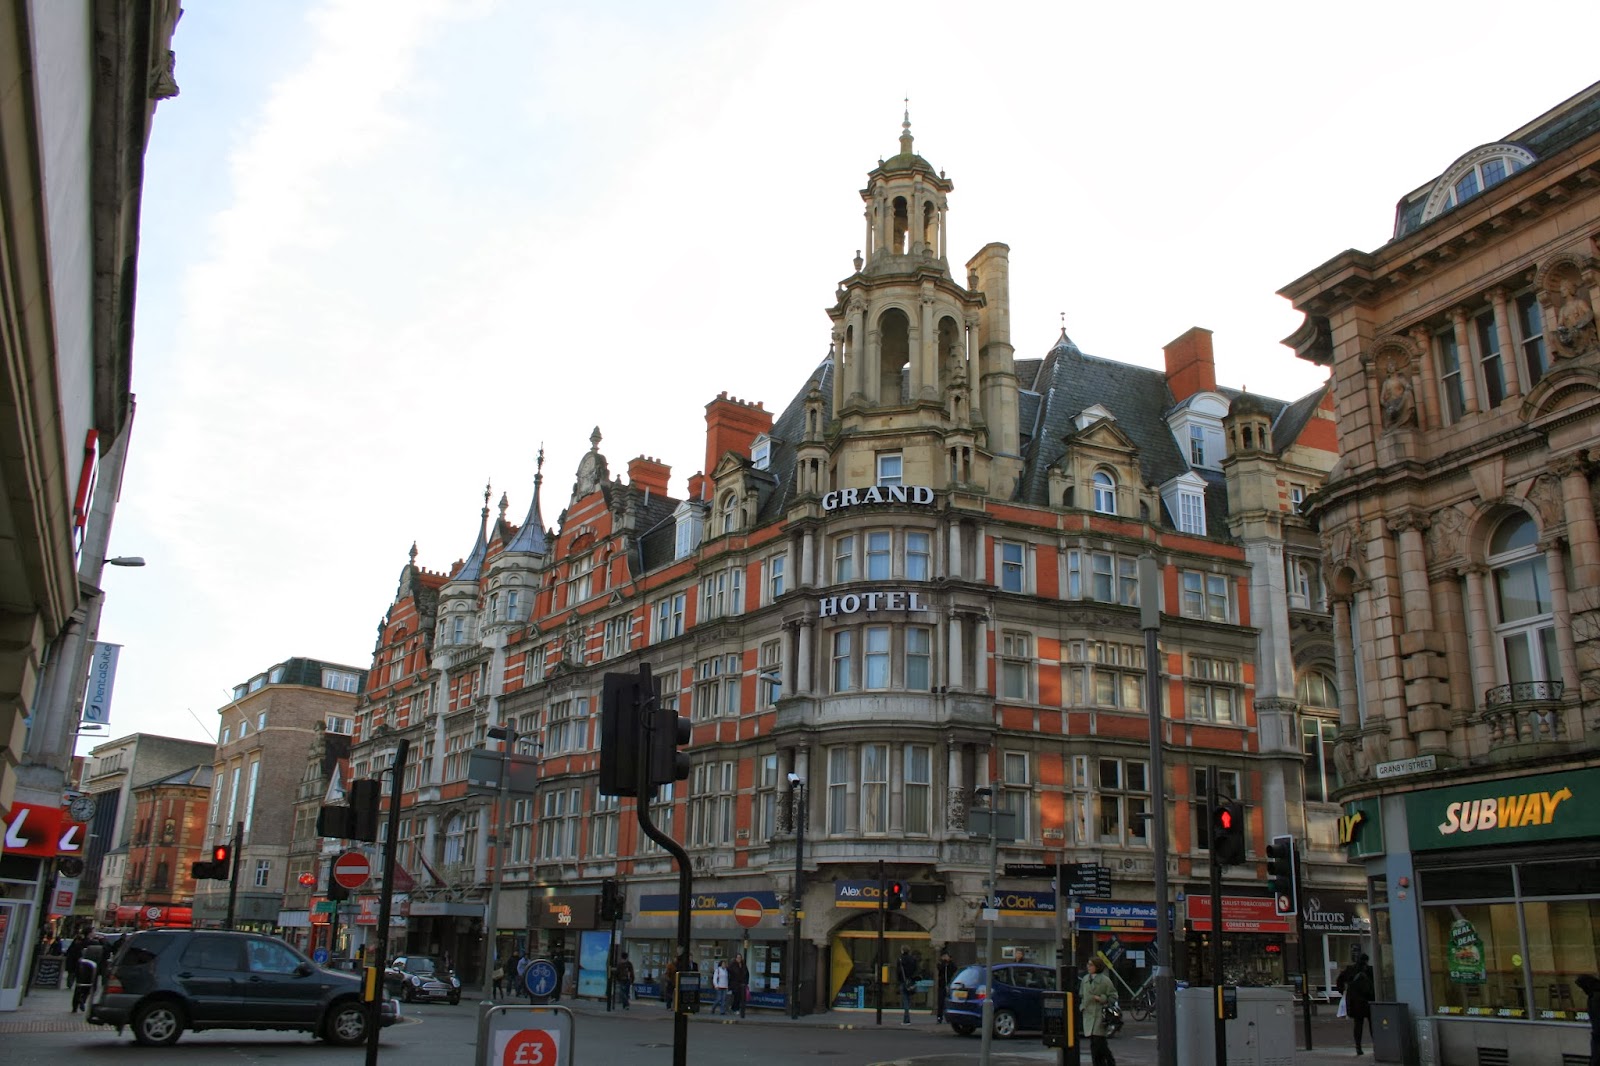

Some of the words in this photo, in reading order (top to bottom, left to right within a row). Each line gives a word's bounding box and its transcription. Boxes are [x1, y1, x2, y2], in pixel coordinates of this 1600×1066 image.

[822, 485, 934, 511] GRAND
[819, 591, 927, 617] HOTEL
[93, 644, 112, 703] DentalSuite
[1379, 763, 1405, 775] GRANBY
[1408, 759, 1432, 770] STREET
[1438, 787, 1573, 835] SUBWAY
[840, 886, 861, 897] Alex
[863, 886, 888, 897] Clak
[1006, 895, 1036, 908] Clark
[1085, 906, 1108, 914] Konica
[1110, 906, 1131, 916] Digital
[1132, 907, 1149, 915] Photo
[1303, 907, 1345, 923] Mirrors
[558, 912, 572, 926] Shop
[1452, 925, 1471, 937] REAL
[1457, 934, 1477, 946] DEAL
[1438, 1006, 1463, 1014] SUBWAY
[1467, 1006, 1493, 1015] SUBWAY
[1497, 1008, 1525, 1017] SUBWAY
[513, 1042, 544, 1065] £3
